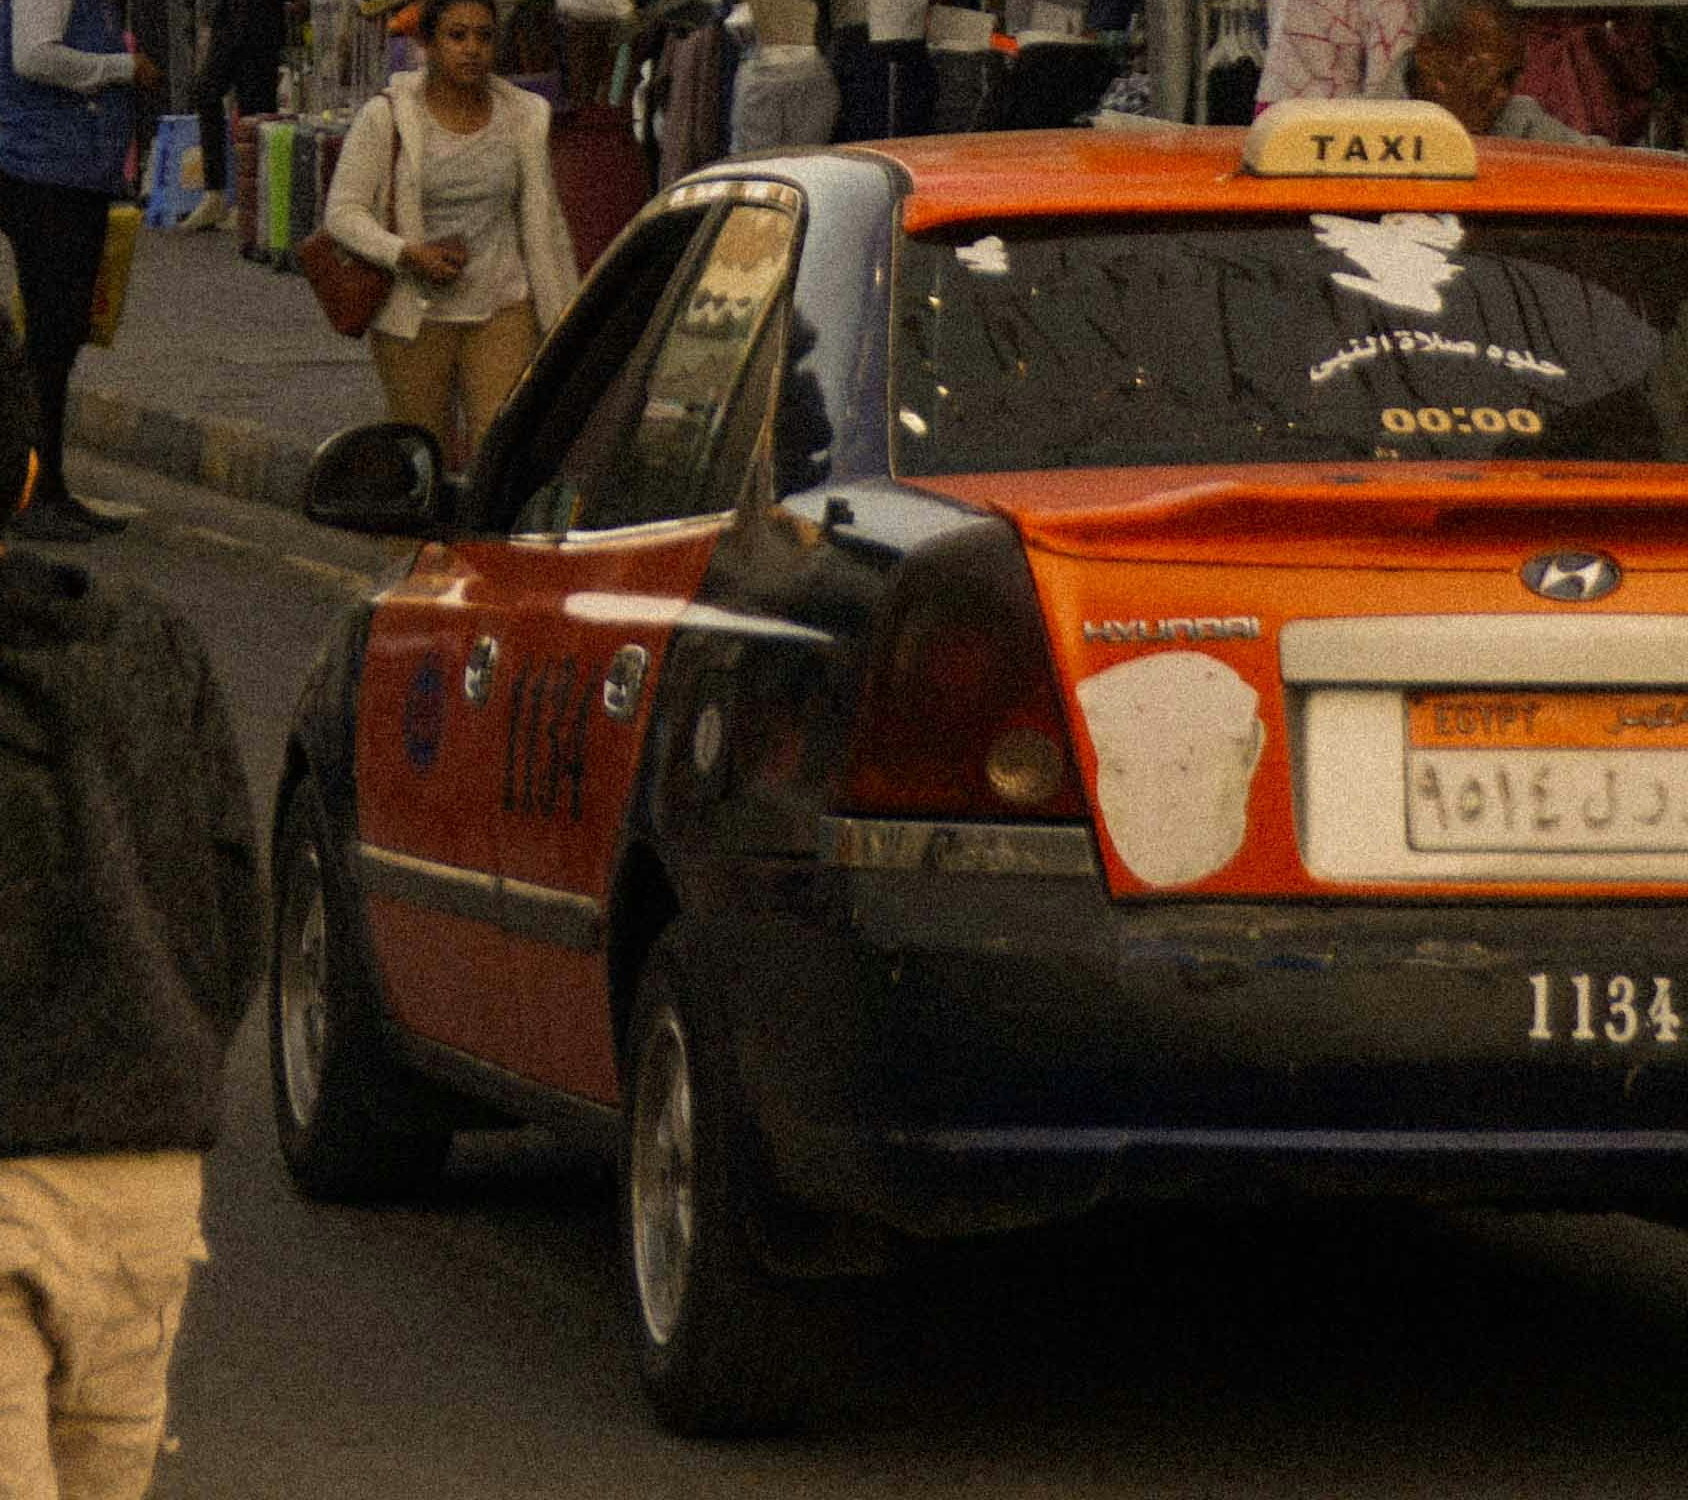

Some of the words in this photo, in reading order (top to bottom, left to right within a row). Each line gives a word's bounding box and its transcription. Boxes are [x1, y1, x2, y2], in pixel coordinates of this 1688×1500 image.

[1311, 134, 1426, 162] TAXI
[1083, 616, 1261, 644] HYUNDAI
[1527, 972, 1680, 1042] 1134
